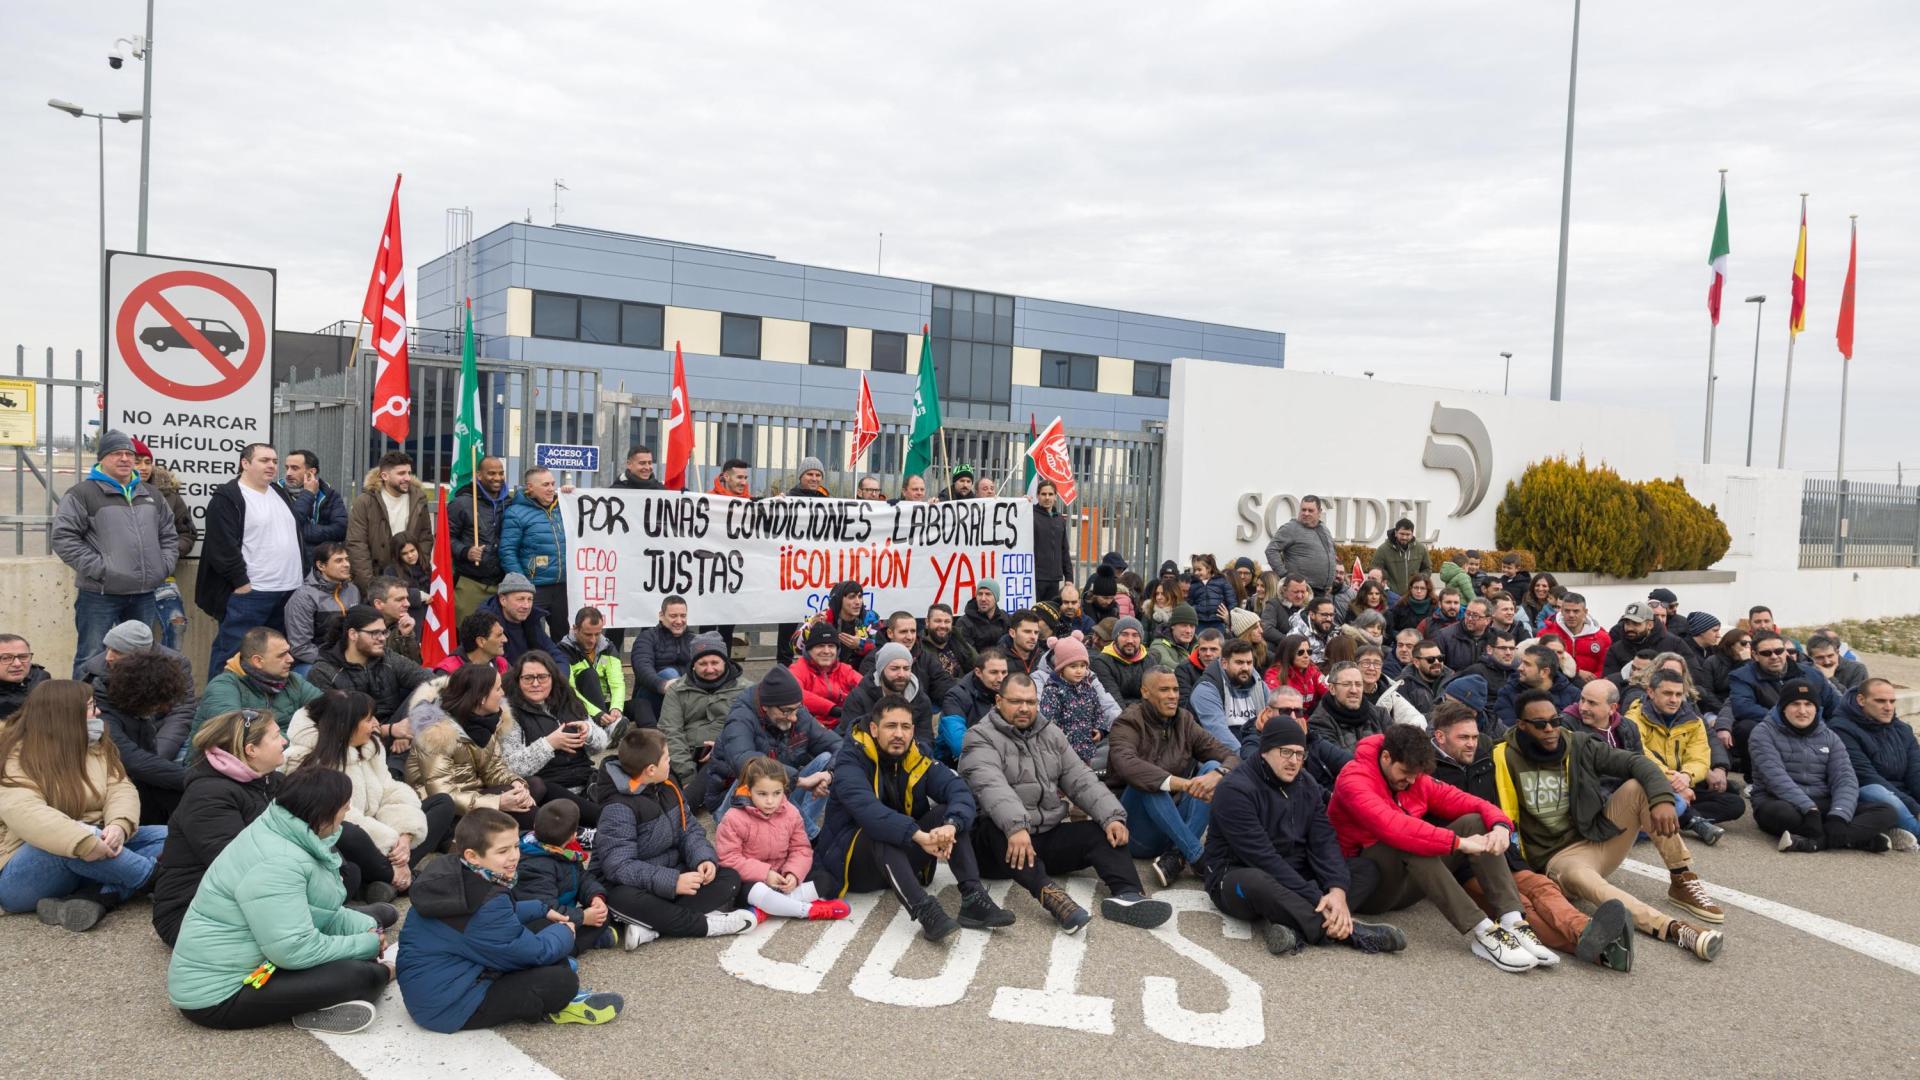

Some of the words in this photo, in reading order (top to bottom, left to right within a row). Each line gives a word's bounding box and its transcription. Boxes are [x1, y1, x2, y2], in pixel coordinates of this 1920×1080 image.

[122, 410, 152, 425] NO
[163, 413, 257, 431] APARCAR
[548, 449, 582, 457] ACCESO
[155, 458, 240, 475] BARRER
[577, 495, 630, 538] POR
[643, 497, 710, 538] UNAS
[726, 498, 873, 542] CONDICIONES
[892, 502, 1018, 549] LABORALES
[576, 547, 617, 572] CCOO
[1002, 553, 1033, 575] CCOO
[643, 548, 744, 596] JUSTAS
[584, 576, 616, 602] ELA
[1005, 576, 1032, 596] ELA
[1006, 596, 1032, 613] UGT
[1524, 775, 1569, 792] JACK
[718, 862, 1265, 1049] STOP
